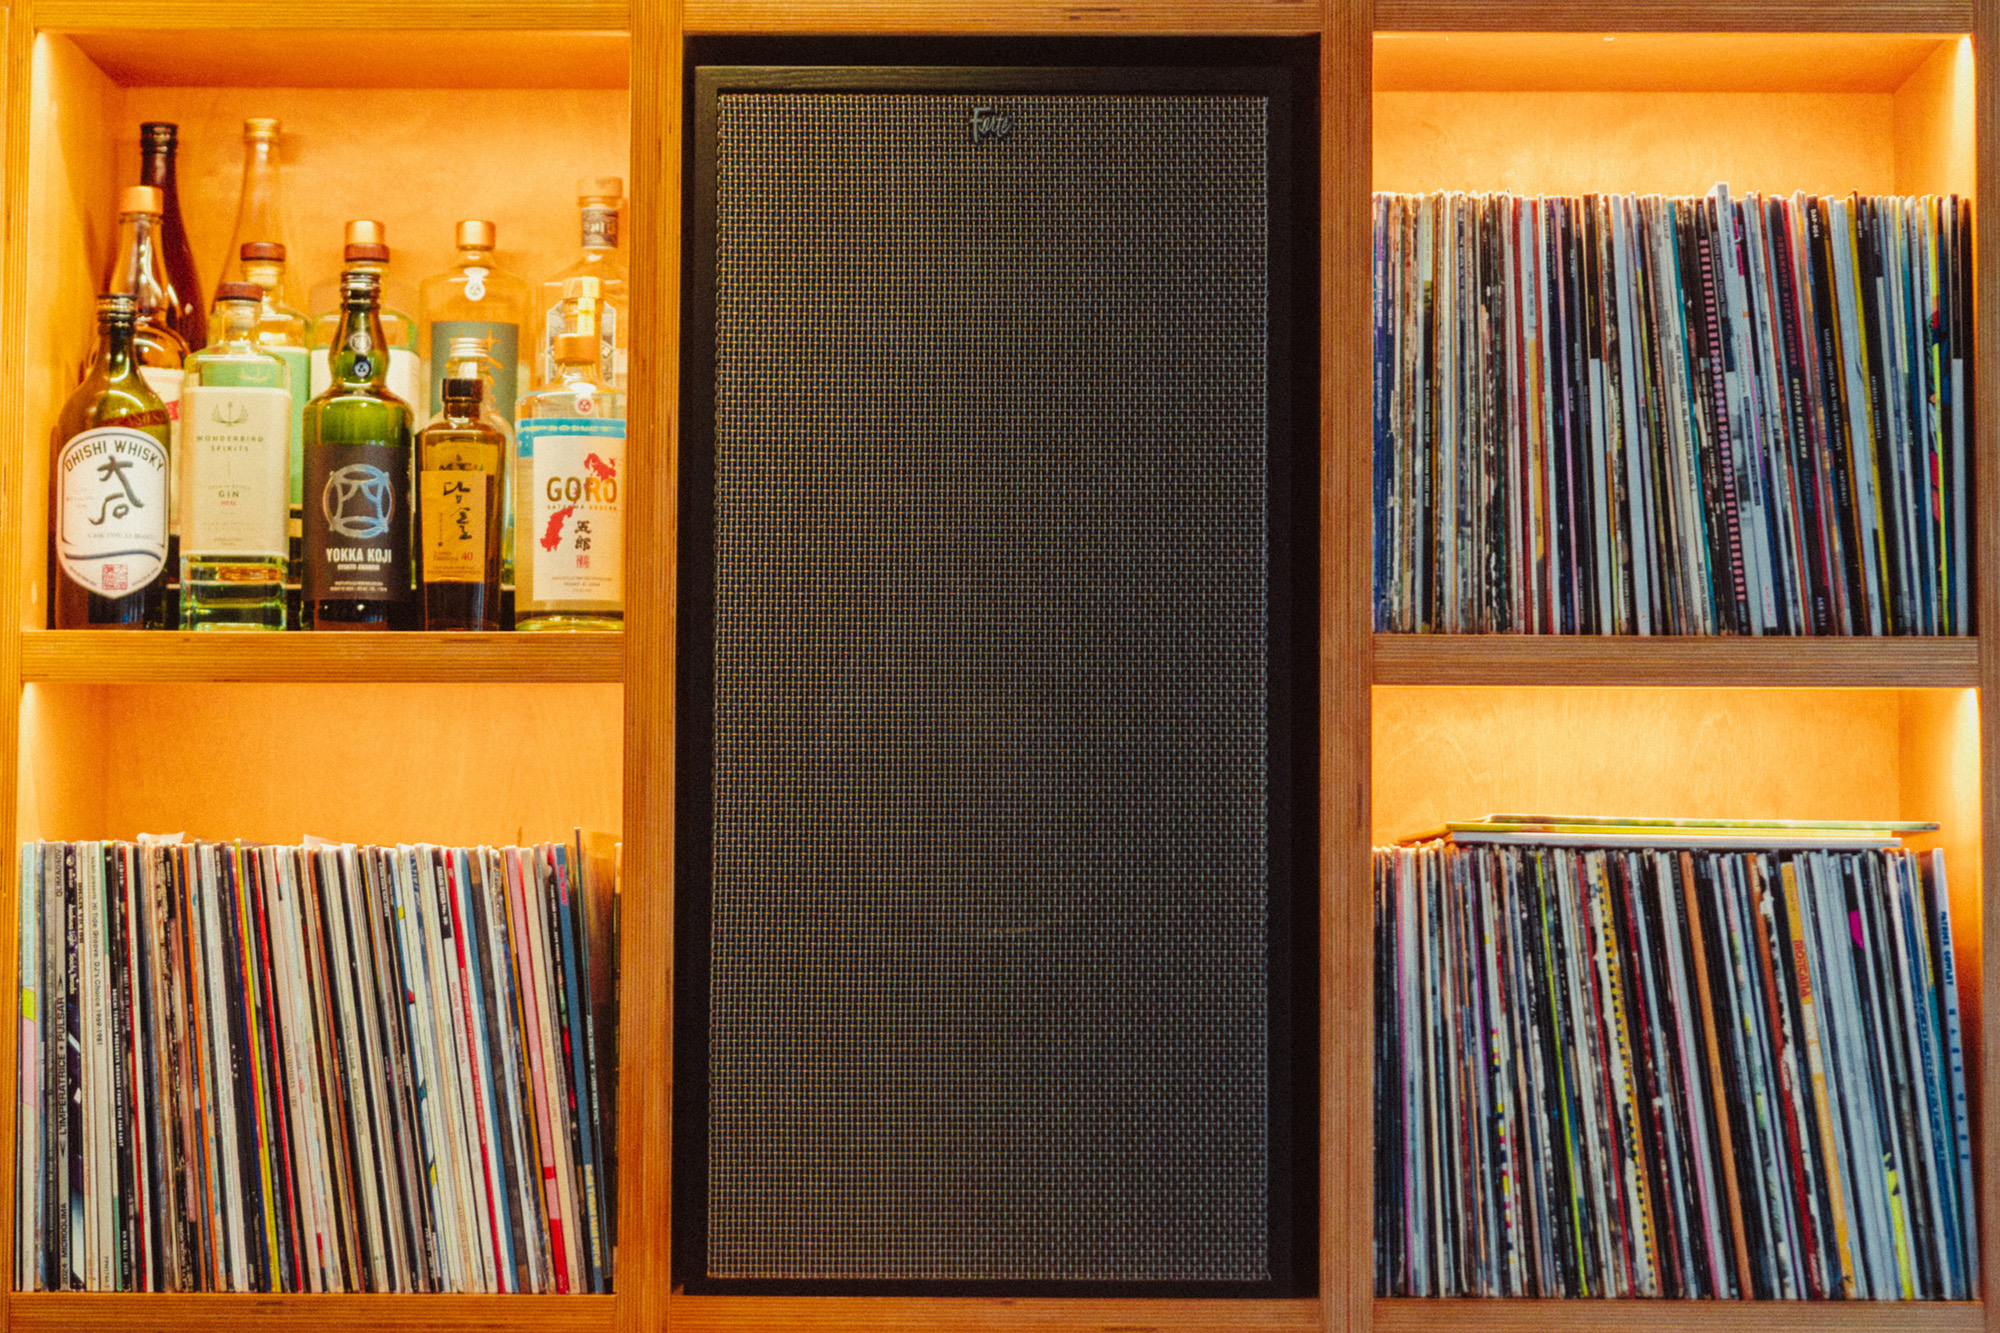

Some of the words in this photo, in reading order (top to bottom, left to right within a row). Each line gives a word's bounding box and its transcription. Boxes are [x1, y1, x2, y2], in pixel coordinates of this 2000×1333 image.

[1811, 208, 1819, 238] DAP-004
[1717, 281, 1726, 303] ORGAN
[1719, 304, 1727, 317] TRIO
[1824, 328, 1833, 356] SHARON
[1827, 359, 1835, 380] JONES
[1793, 377, 1803, 412] SUFJAN
[1829, 382, 1837, 397] AND
[1831, 399, 1839, 411] THE
[196, 435, 264, 443] WONDERBIRD
[1797, 415, 1808, 459] STEVENS
[64, 440, 107, 473] OHISHI
[114, 440, 164, 472] WHISKY
[218, 490, 240, 498] GIN
[546, 476, 618, 504] GORO
[1839, 470, 1848, 507] NATURALLY
[326, 547, 364, 563] YOKKA
[367, 548, 392, 563] KOJI
[461, 551, 473, 561] 40
[558, 864, 566, 879] BAD
[560, 880, 568, 905] BUNNY
[92, 902, 98, 911] Hi
[1940, 911, 1950, 946] PATRICK
[1943, 950, 1954, 986] COWLEY
[451, 981, 459, 1007] SUPER
[57, 996, 65, 1042] PULSAR
[454, 1009, 462, 1035] DISCO
[457, 1035, 466, 1064] PIRATA
